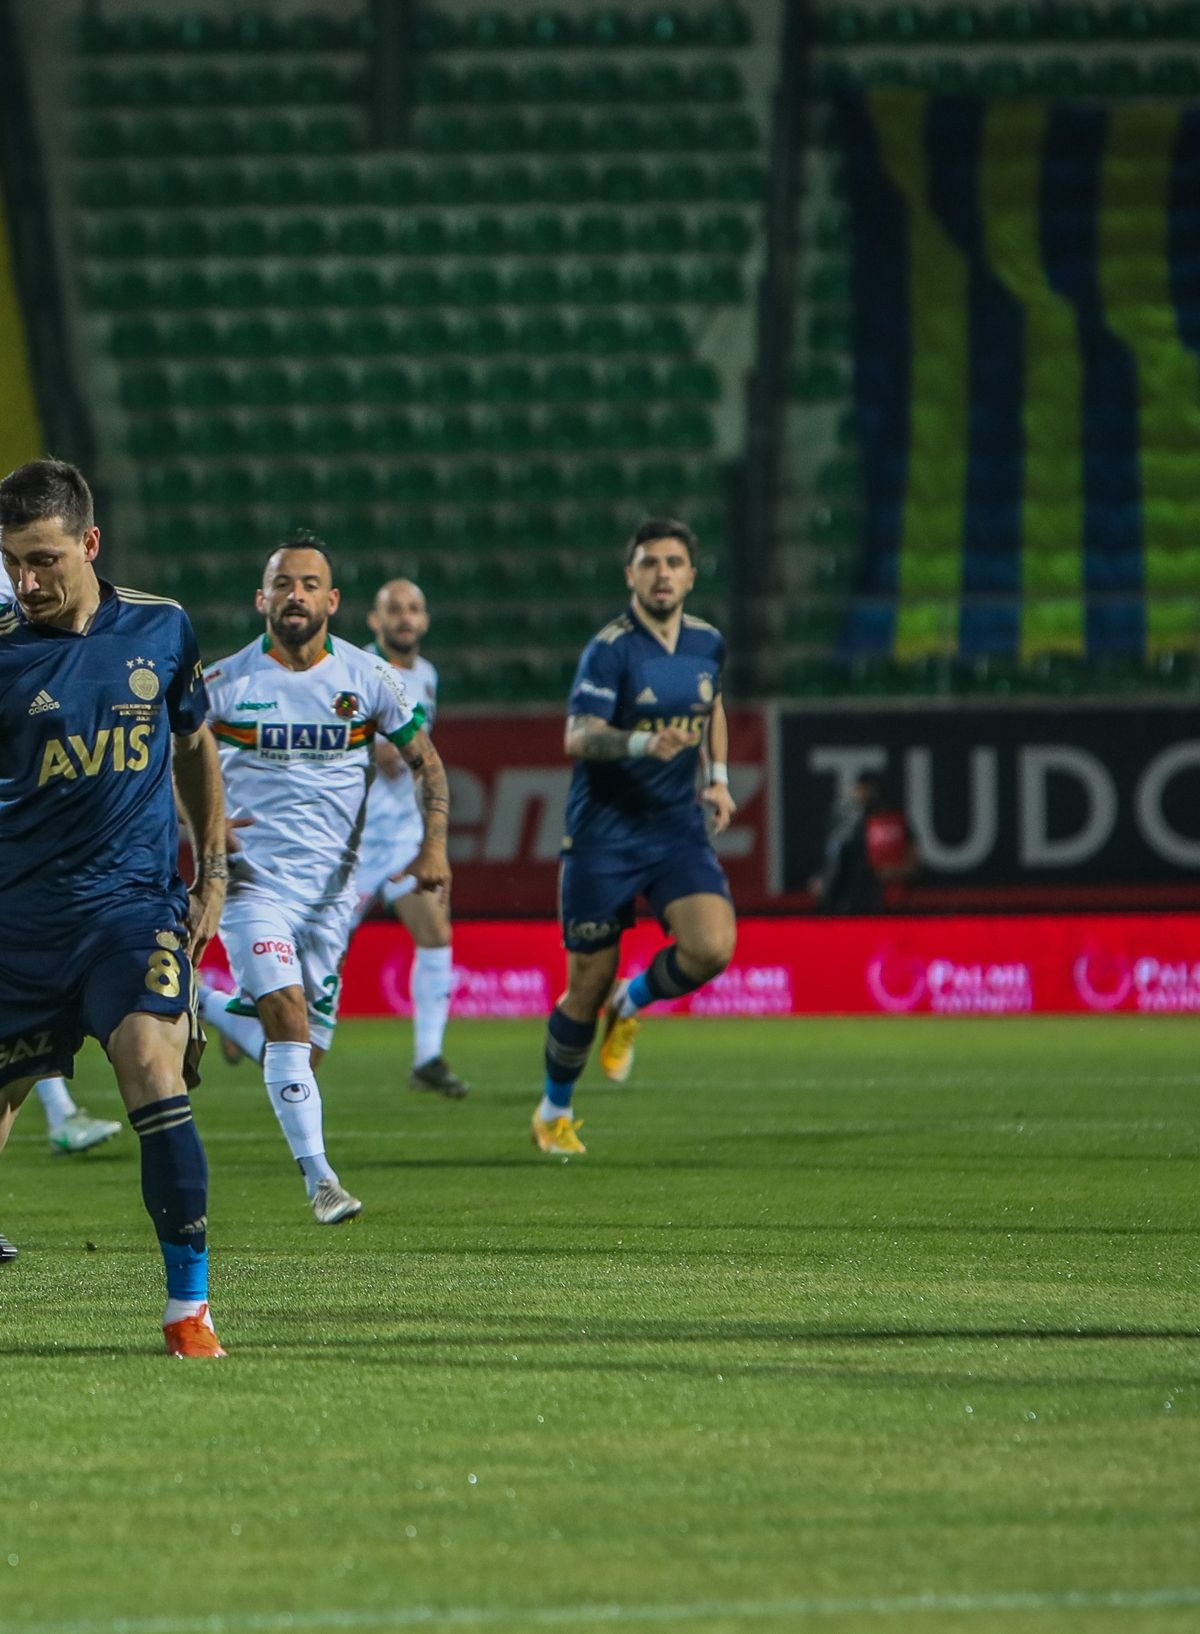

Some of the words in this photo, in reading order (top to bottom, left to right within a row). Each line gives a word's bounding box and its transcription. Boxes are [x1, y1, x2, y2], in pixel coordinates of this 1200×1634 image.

[28, 701, 61, 716] adidas
[235, 701, 279, 712] uhlsport
[265, 728, 343, 747] TAV
[37, 723, 152, 788] AVIS
[145, 950, 181, 998] 8
